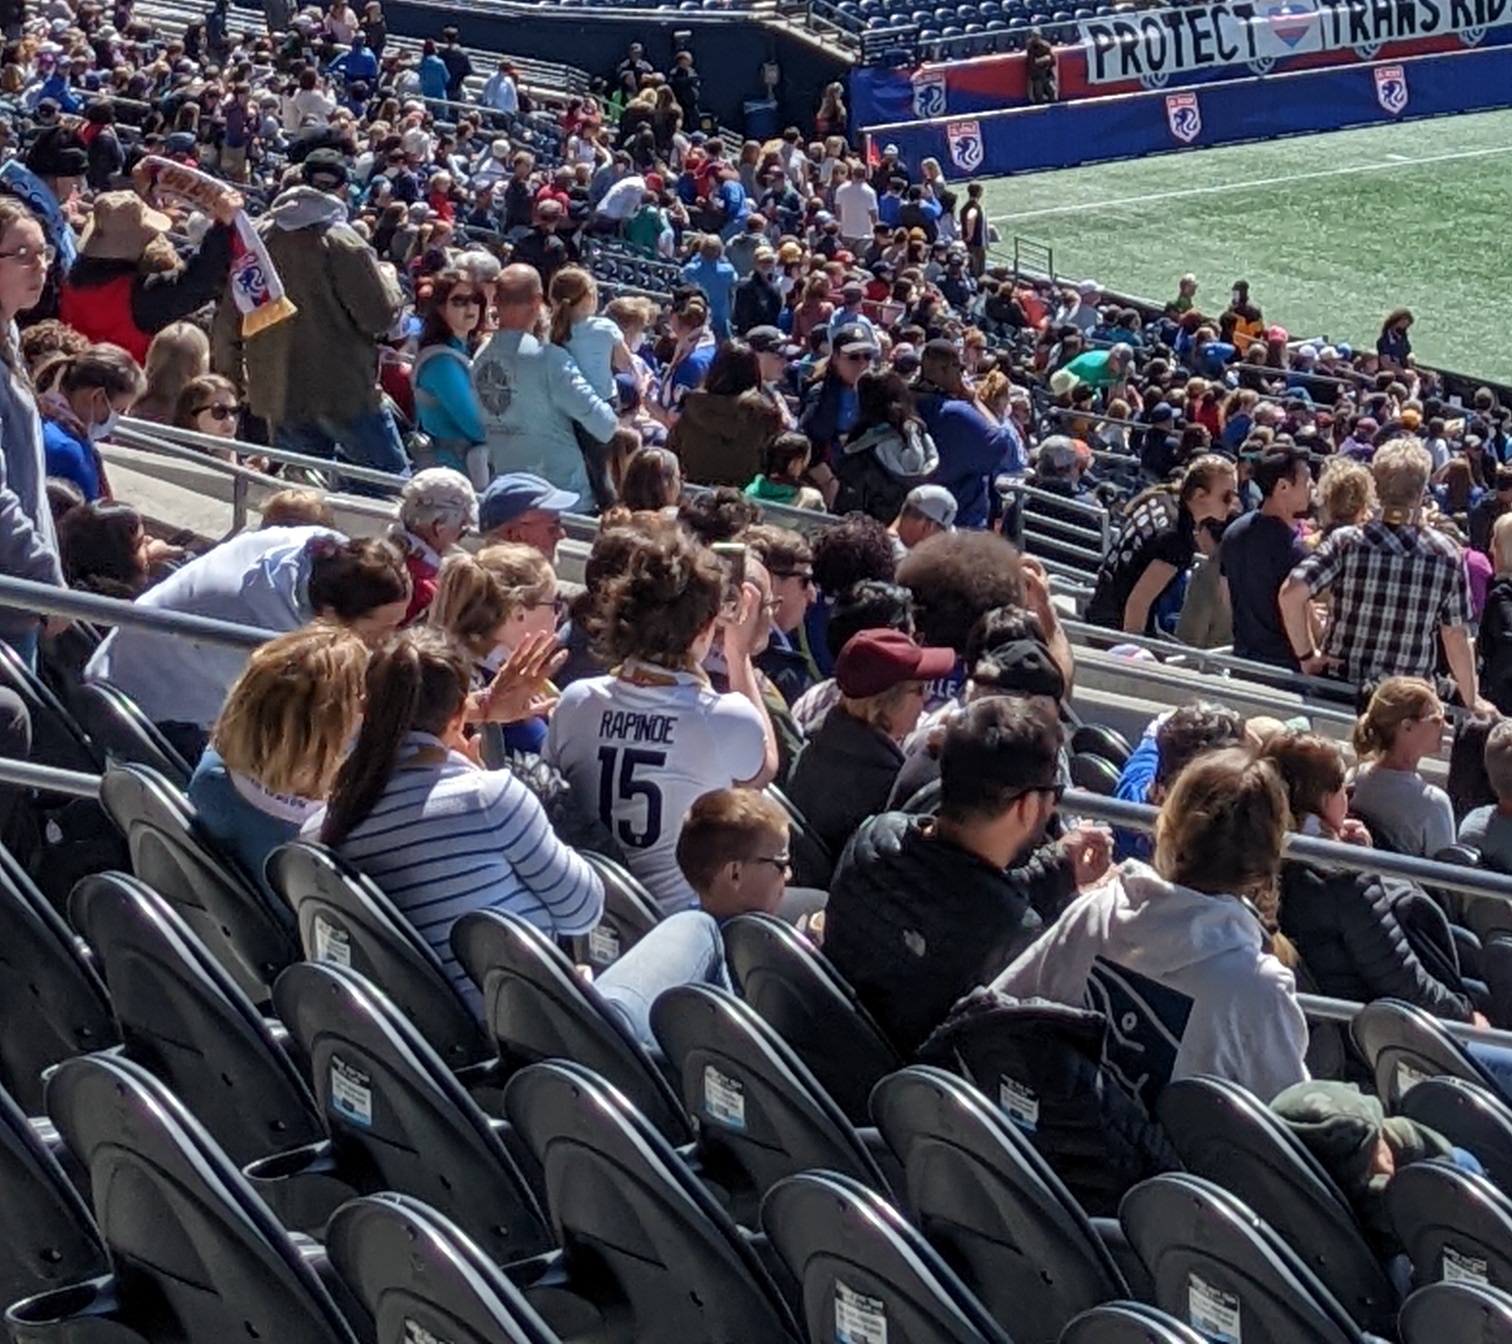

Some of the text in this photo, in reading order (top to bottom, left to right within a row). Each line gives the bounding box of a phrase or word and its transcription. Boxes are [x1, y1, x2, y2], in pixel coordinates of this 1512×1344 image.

[1086, 2, 1256, 79] PROTECT
[599, 710, 679, 745] RAPINOE
[597, 745, 668, 849] 15
